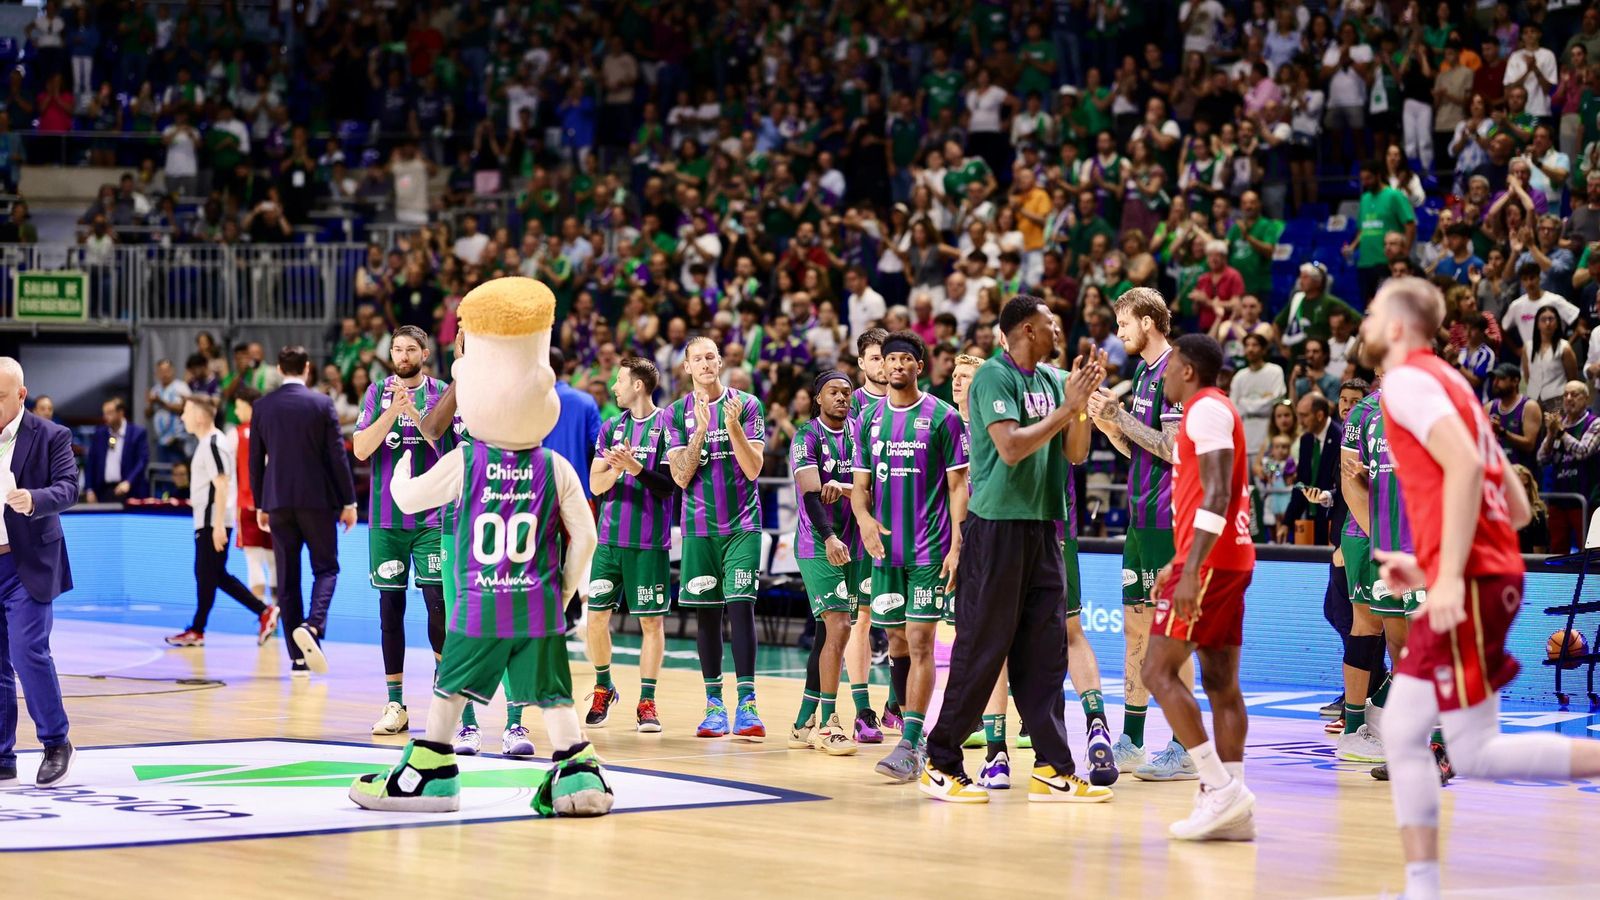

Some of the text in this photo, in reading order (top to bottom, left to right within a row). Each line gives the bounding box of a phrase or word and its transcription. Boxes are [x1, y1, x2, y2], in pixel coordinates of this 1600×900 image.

[886, 440, 927, 450] Fundación
[886, 448, 914, 459] Unicaja
[486, 463, 534, 480] Chicui
[473, 512, 539, 566] 00
[474, 570, 535, 588] Andalucía
